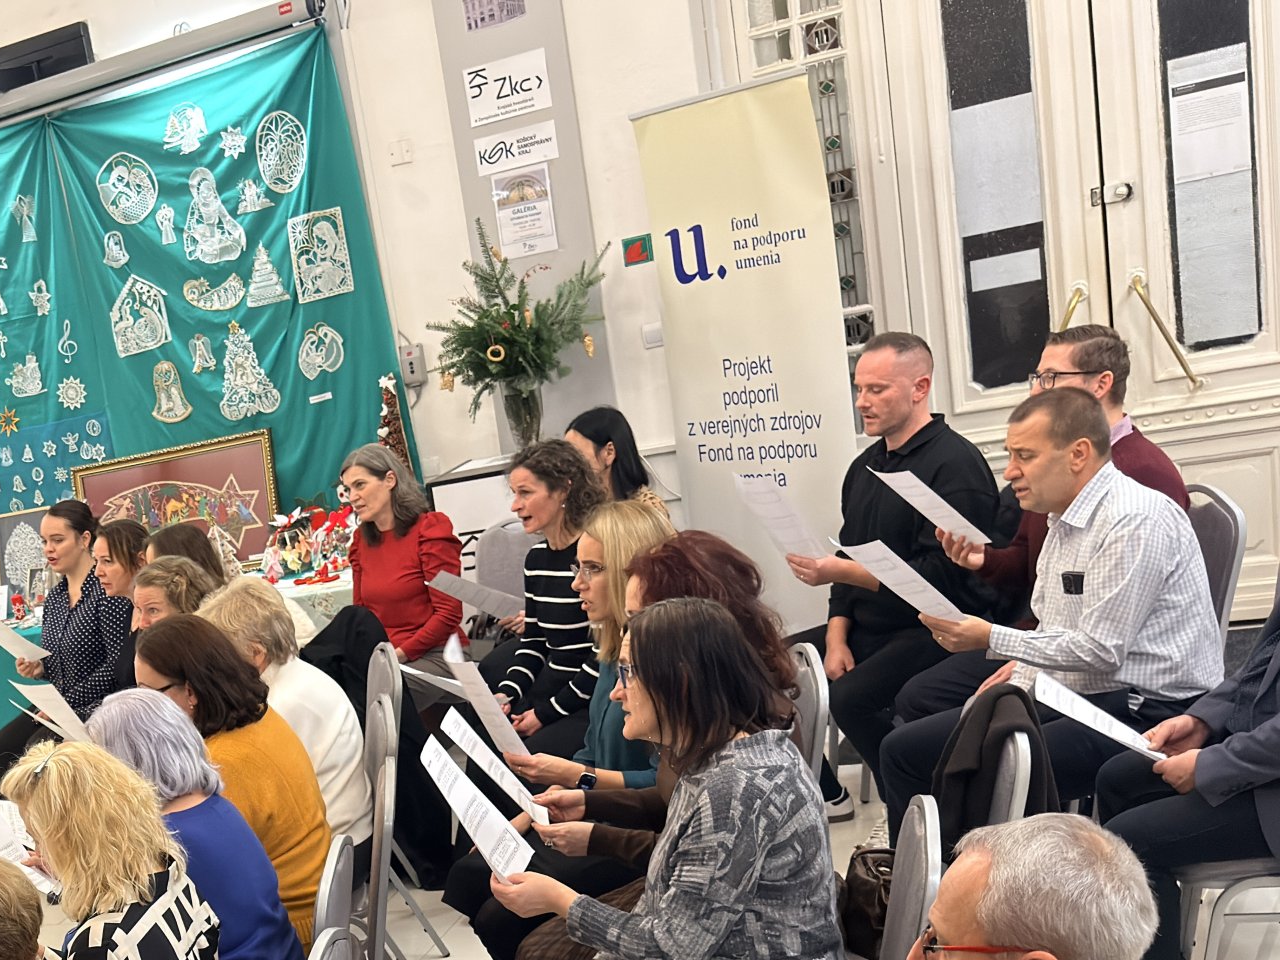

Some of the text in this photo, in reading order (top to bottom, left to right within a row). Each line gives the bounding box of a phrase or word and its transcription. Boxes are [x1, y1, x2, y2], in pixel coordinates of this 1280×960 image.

[731, 213, 759, 231] fond
[733, 227, 807, 251] na podporu
[735, 250, 781, 270] umenia
[722, 355, 773, 381] Projekt
[723, 383, 779, 410] podporil
[687, 410, 822, 438] z verejných zdrojov
[698, 440, 818, 464] Fond na podporu
